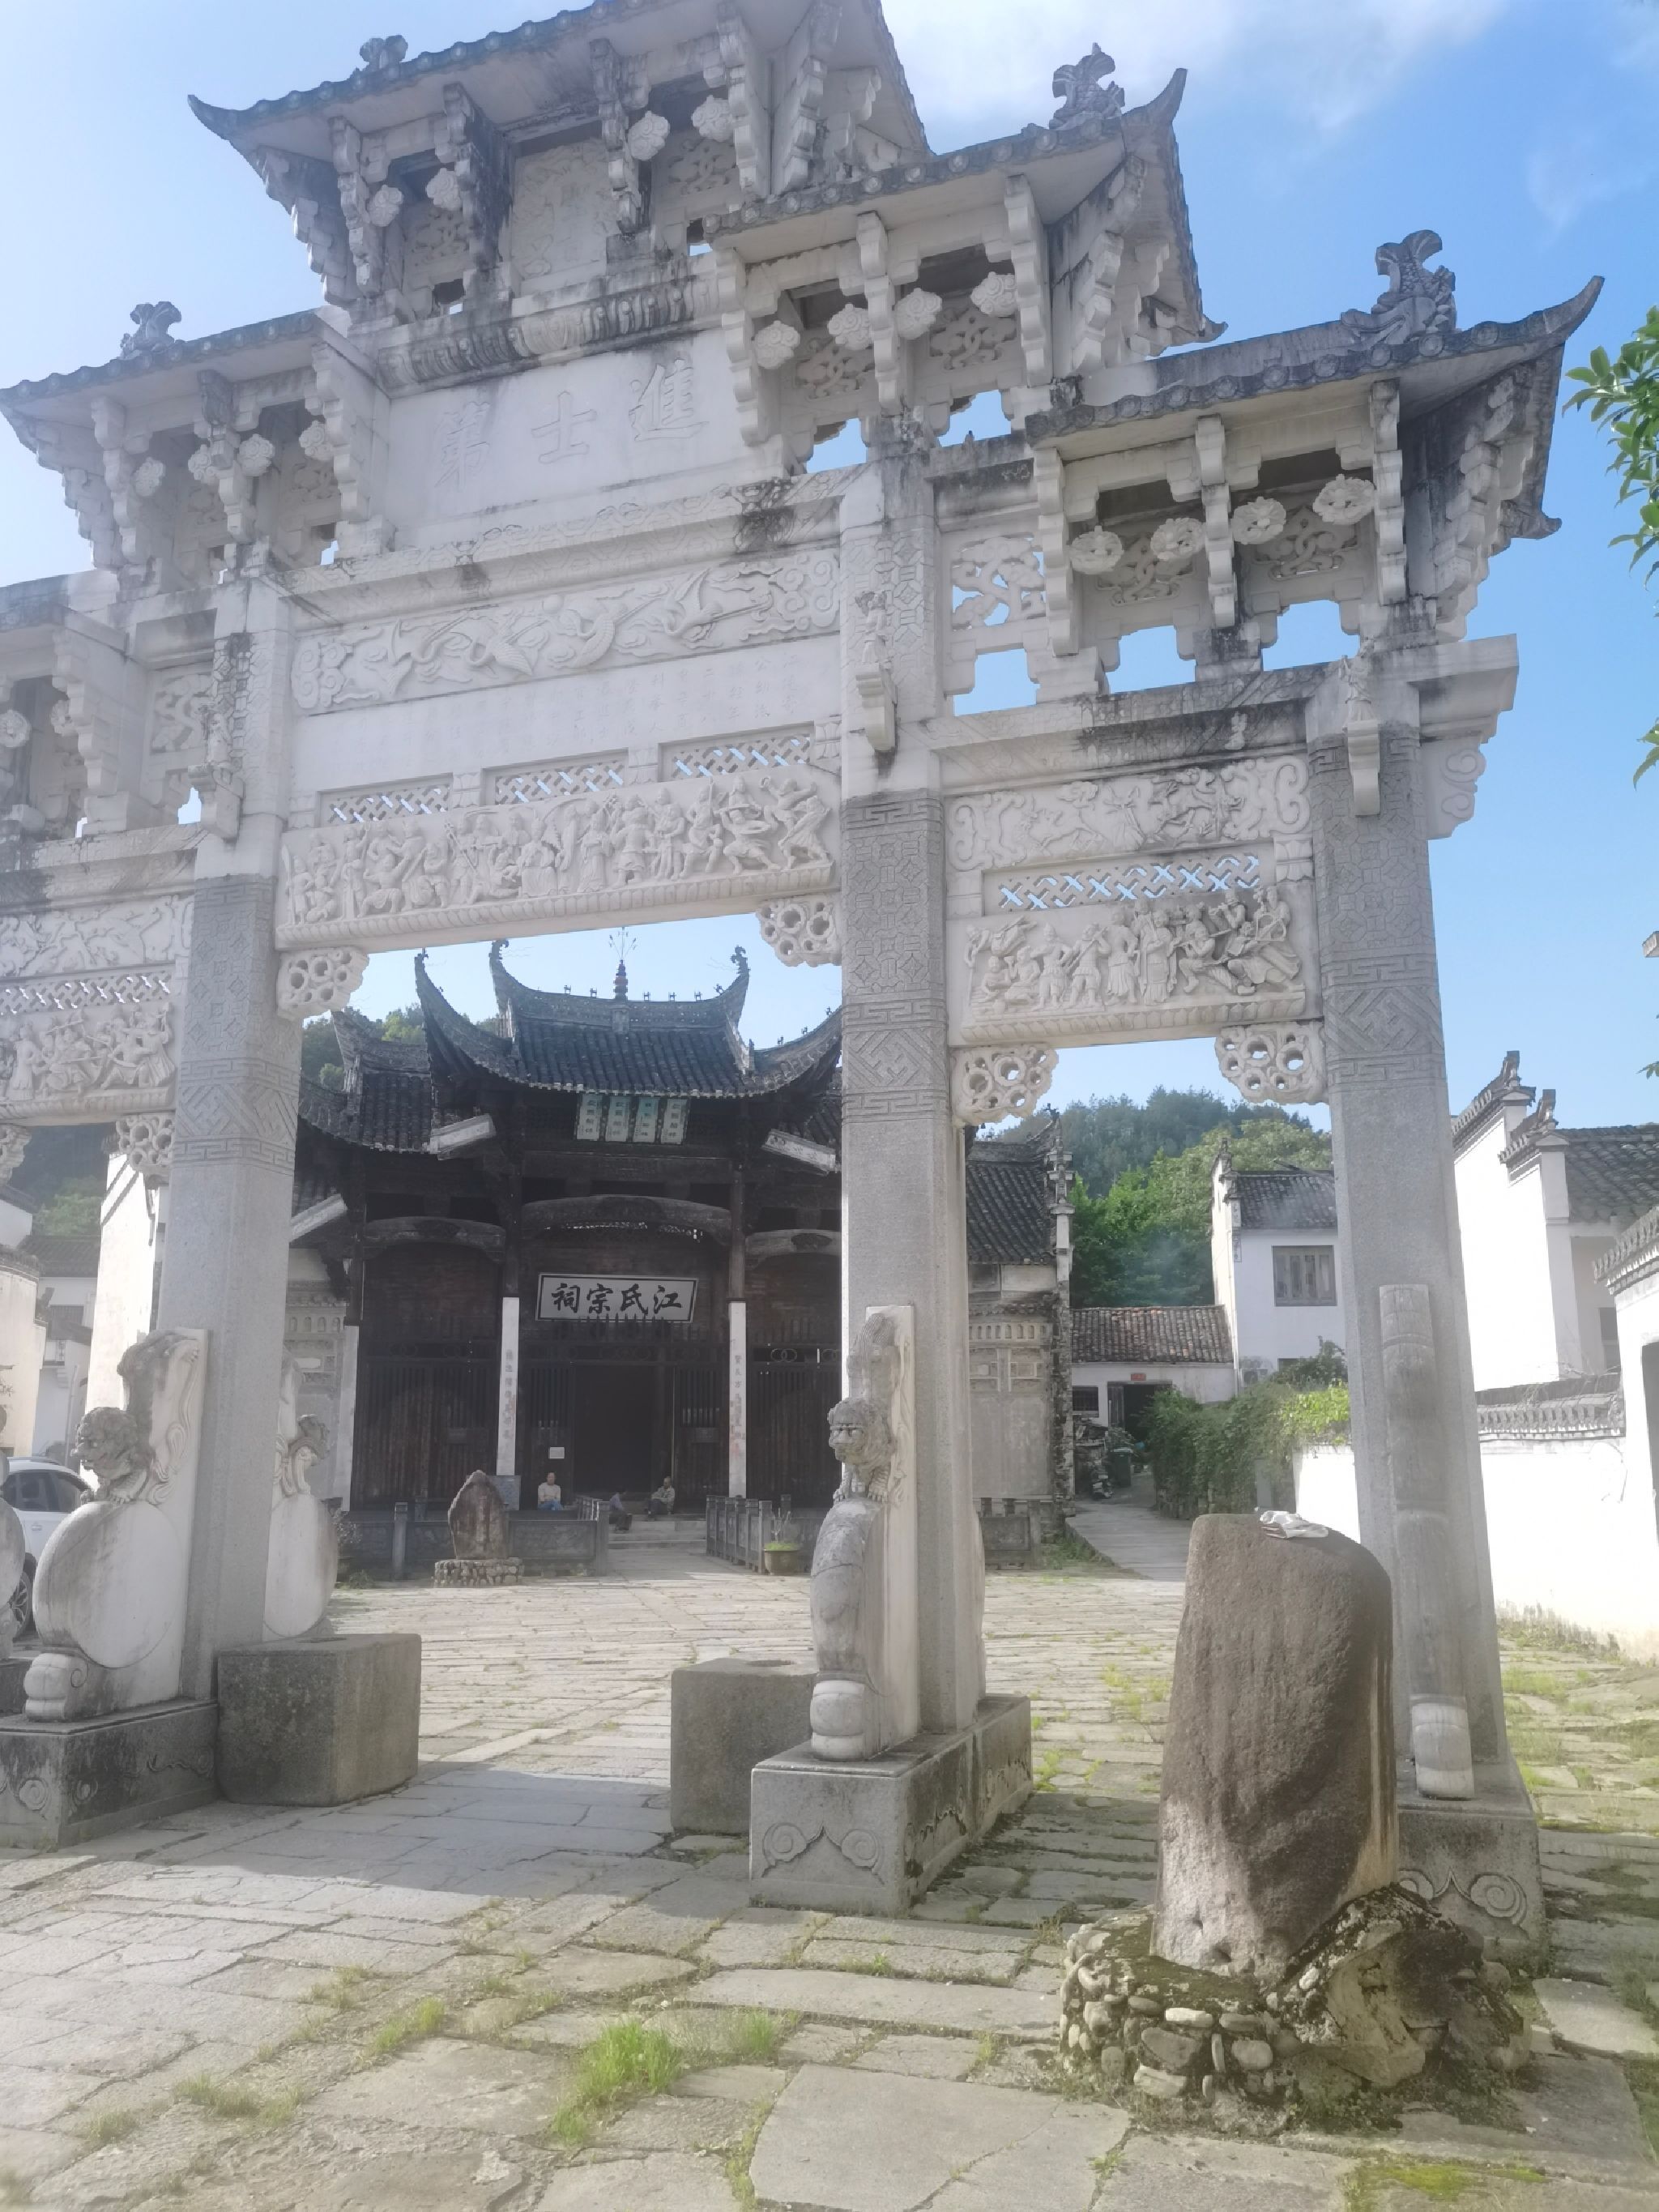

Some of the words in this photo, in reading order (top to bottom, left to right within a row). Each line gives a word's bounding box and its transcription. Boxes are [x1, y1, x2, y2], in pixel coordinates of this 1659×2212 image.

[433, 358, 710, 492] 進士第
[551, 1282, 682, 1315] 江氏宗祠
